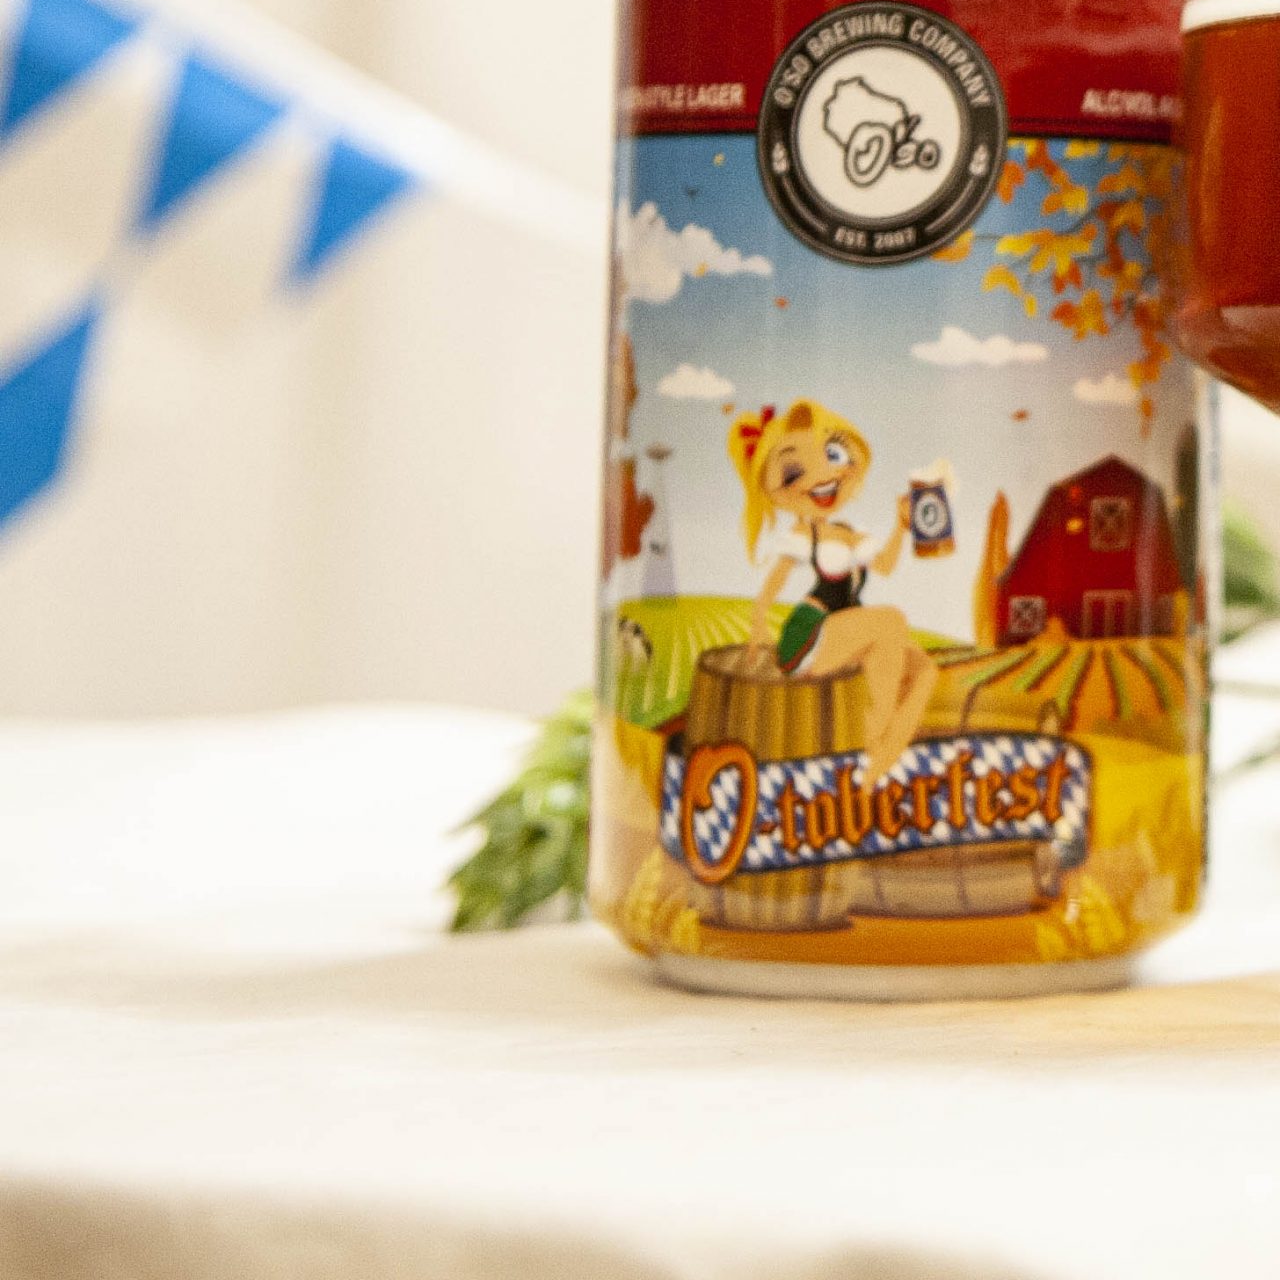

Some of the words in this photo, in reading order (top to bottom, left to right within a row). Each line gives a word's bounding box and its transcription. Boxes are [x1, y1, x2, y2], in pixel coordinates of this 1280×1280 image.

[806, 13, 904, 59] BREWING
[908, 19, 991, 107] COMPANY
[687, 82, 745, 110] LAGER
